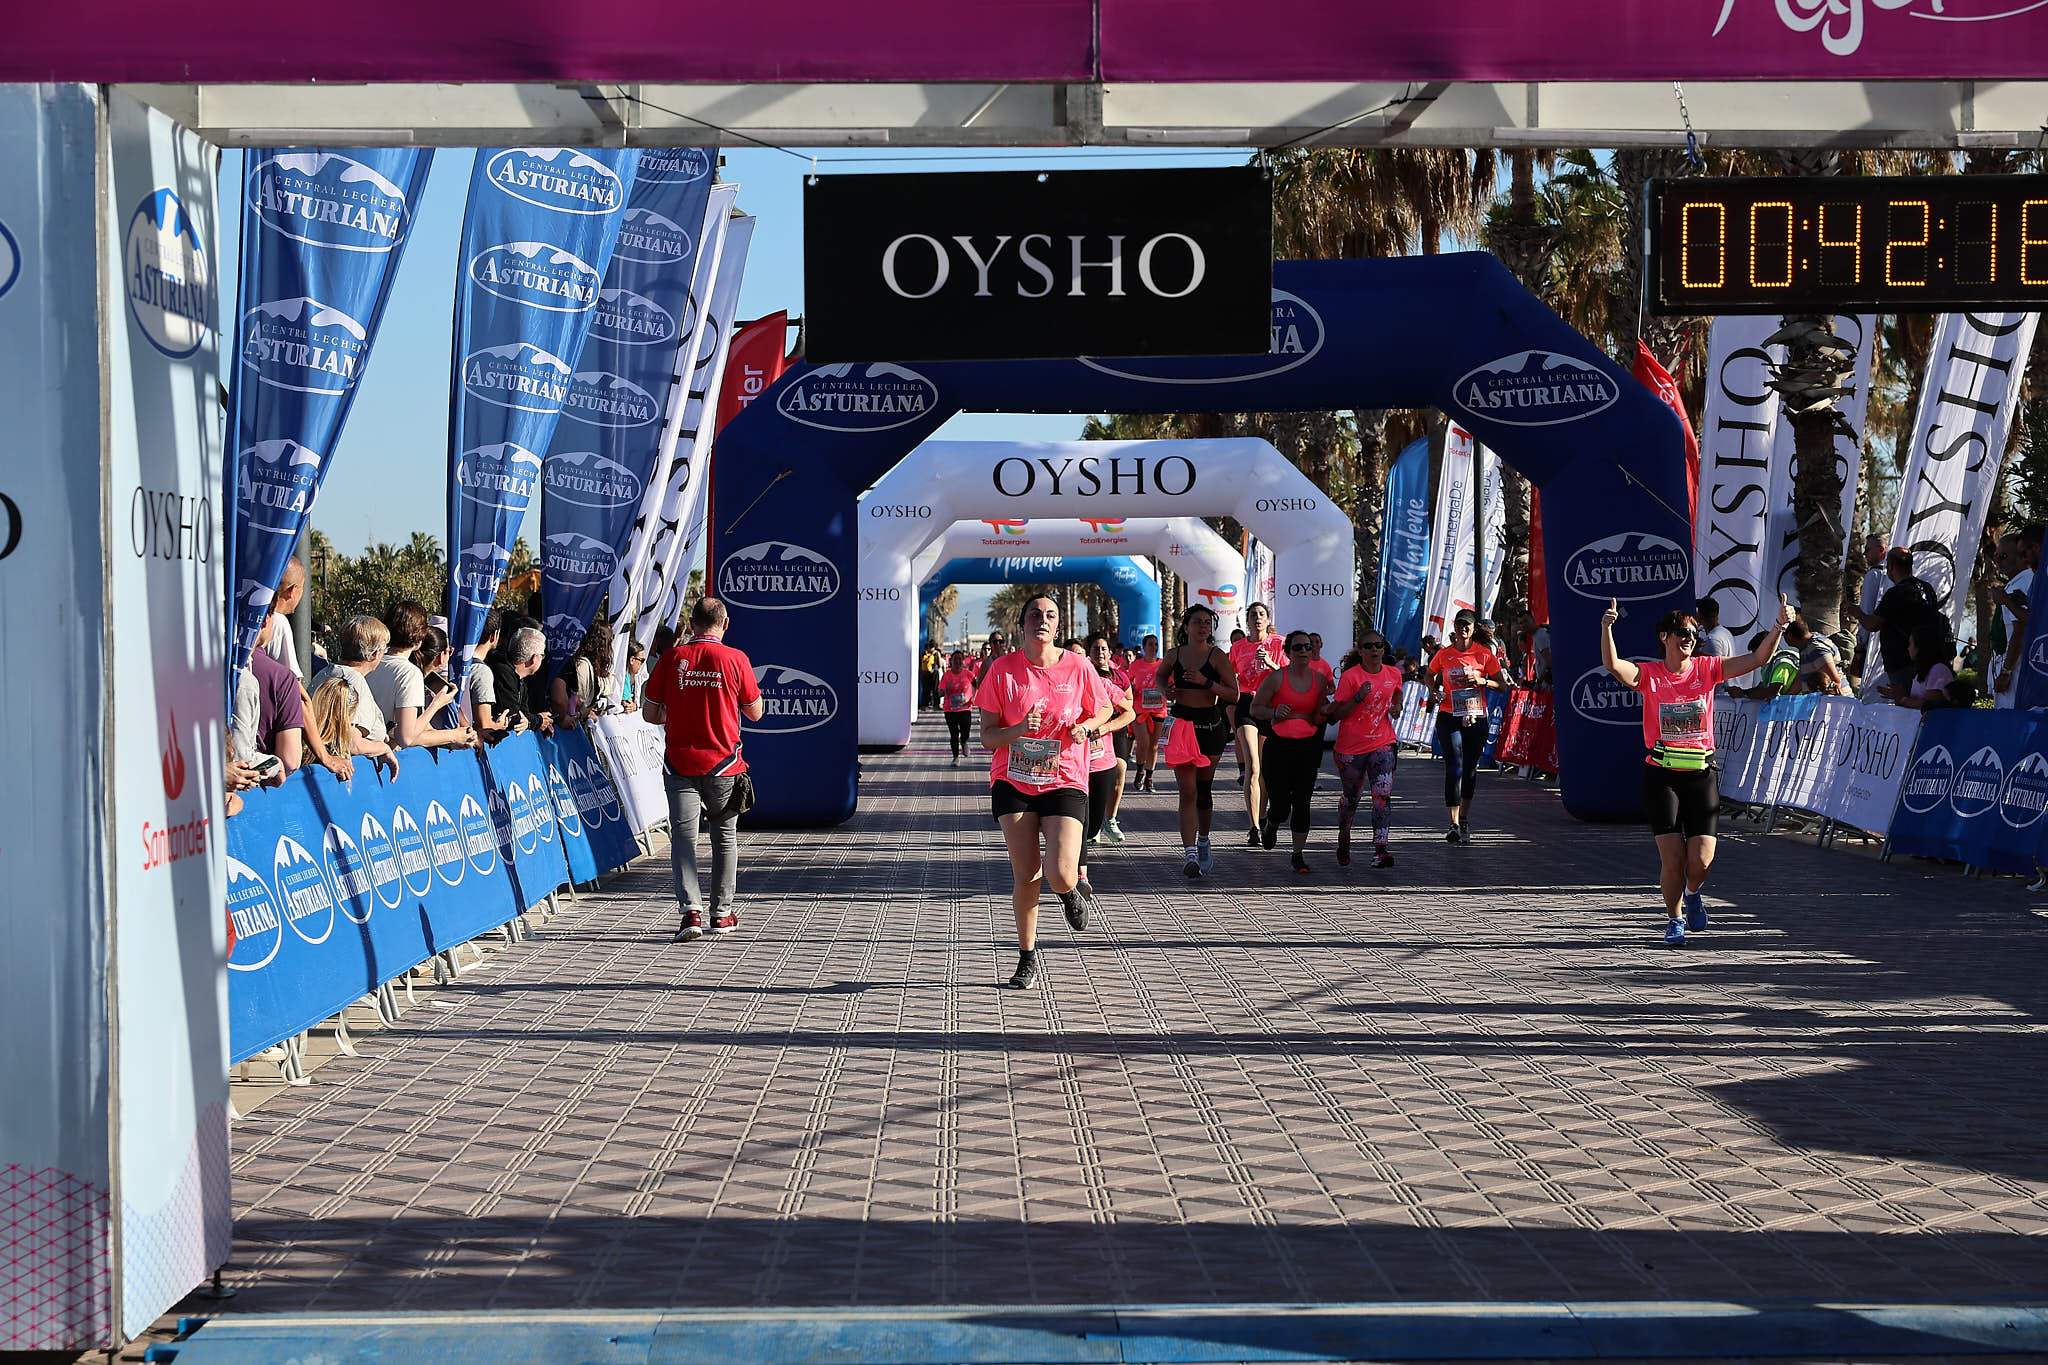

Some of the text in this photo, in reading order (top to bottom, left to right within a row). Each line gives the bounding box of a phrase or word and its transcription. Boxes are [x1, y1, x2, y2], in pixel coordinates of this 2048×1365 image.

[638, 155, 700, 176] TURIANA
[275, 175, 401, 212] CENTRAL LECHERA
[496, 158, 616, 208] ASTURIANA
[256, 174, 401, 240] ASTURIANA
[616, 231, 682, 257] TURIANA
[479, 257, 593, 303] ASTURIANA
[882, 233, 1205, 299] OYSHO
[132, 236, 205, 325] ASTURIANA
[593, 311, 666, 338] TURIANA
[244, 320, 357, 380] ASTURIAN
[466, 360, 568, 402] ASTURIAN
[813, 381, 923, 391] CENTRAL LECHERA
[1488, 372, 1601, 387] CENTRAL LECHERA
[564, 393, 649, 420] STURIANA
[786, 385, 925, 413] ASTURIANA
[1467, 381, 1610, 409] ASTURIANA
[545, 464, 633, 499] ASTURIANA
[993, 455, 1197, 497] OYSHO
[1256, 498, 1316, 512] OYSHO
[1708, 347, 1778, 637] OYSHO
[131, 486, 212, 564] OYSHO
[871, 505, 932, 518] OYSHO
[982, 538, 1030, 546] TotalEnergies
[1079, 536, 1128, 545] TotalEnergies
[1390, 498, 1428, 592] Marlene
[738, 564, 829, 573] CENTRAL LECHERA
[1591, 552, 1682, 565] CENTRAL LECHERA
[722, 567, 832, 593] ASTURIANA
[1573, 560, 1684, 587] ASTURIANA
[857, 588, 900, 601] YSHO
[1288, 583, 1344, 597] OYSHO
[684, 679, 709, 687] TONY
[685, 670, 722, 679] SPEAKER
[781, 688, 826, 696] LECHERA
[1769, 720, 1826, 762] OYSHO
[1838, 723, 1900, 780] OYSHO
[1905, 770, 1948, 796] ASTURIANA
[1953, 772, 1997, 801] ASTURIANA
[2002, 776, 2047, 811] ASTURIANA
[142, 809, 209, 871] Santander
[231, 901, 279, 941] URIANA
